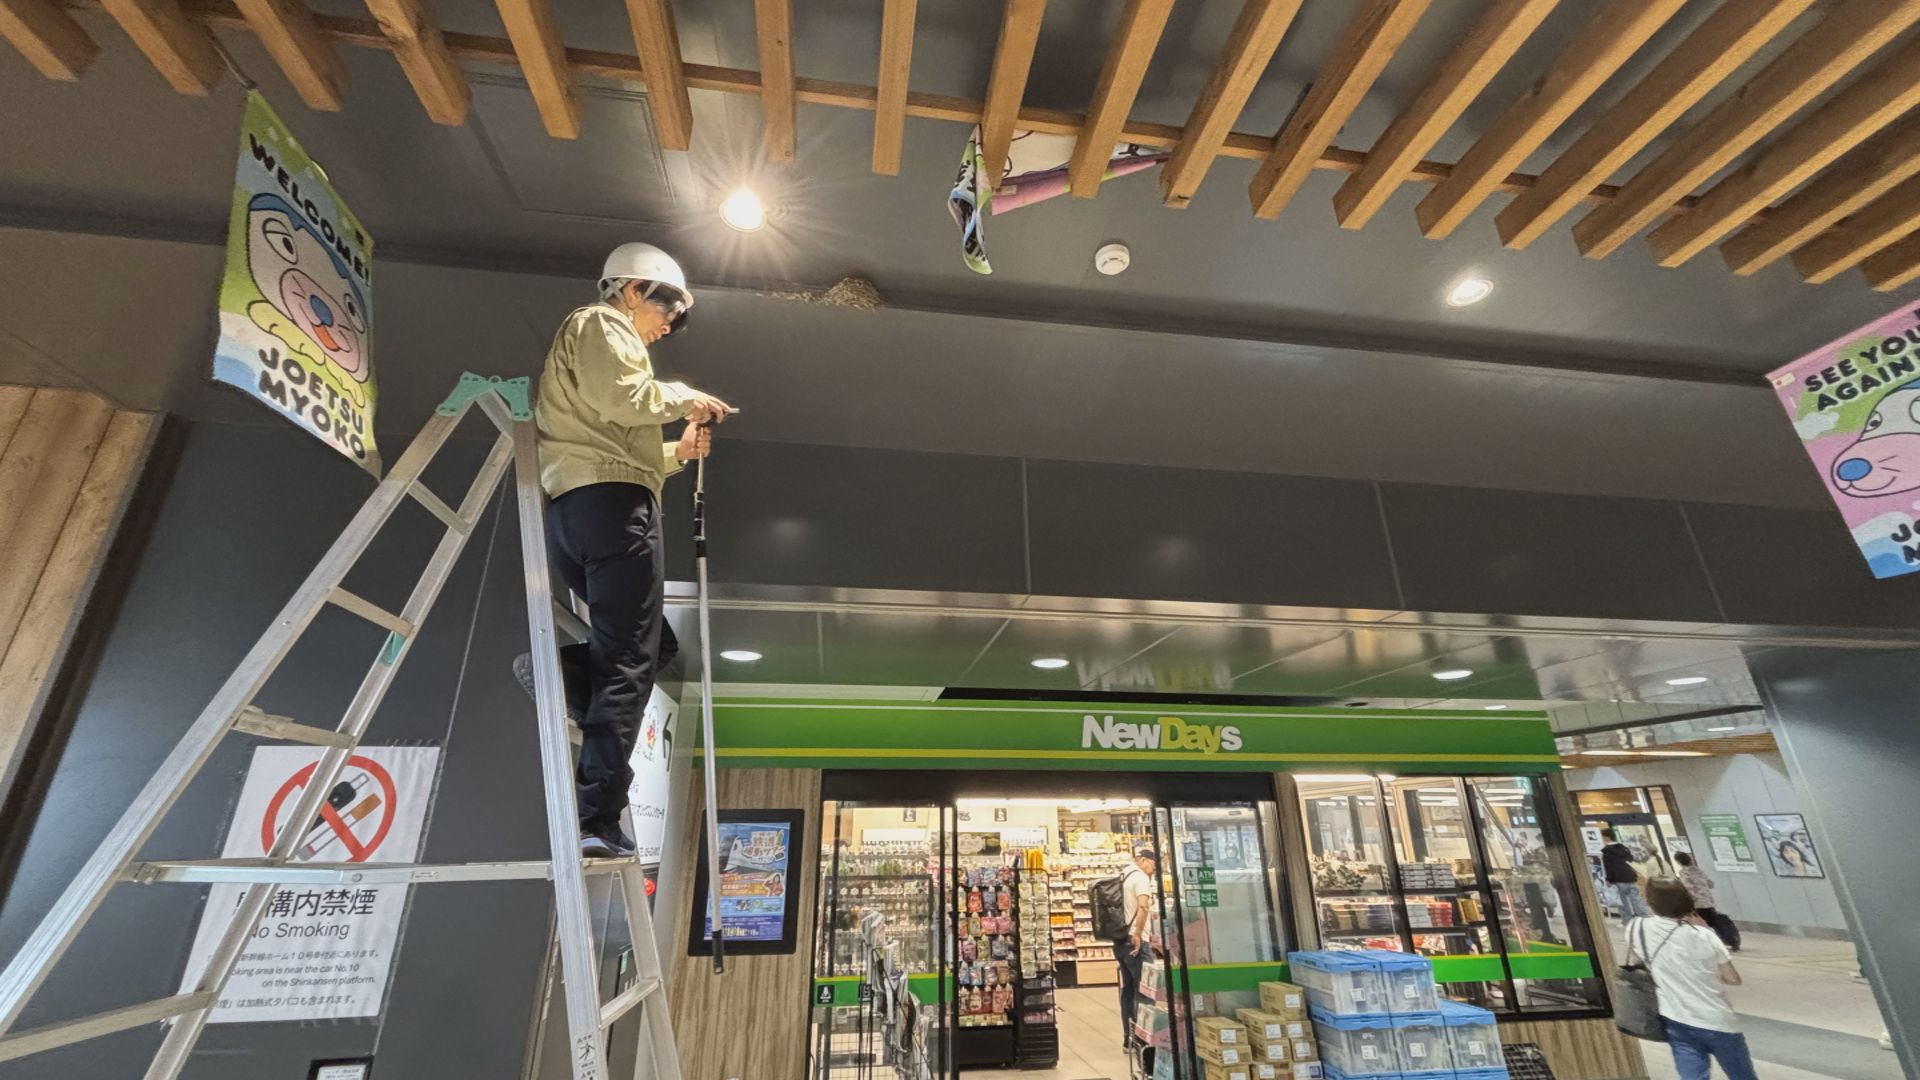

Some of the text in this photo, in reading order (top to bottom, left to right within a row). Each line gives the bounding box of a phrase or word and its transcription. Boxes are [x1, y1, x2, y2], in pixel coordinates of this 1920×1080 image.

[249, 133, 371, 286] WELCOME!
[1805, 324, 1920, 392] SEE YOU
[1817, 348, 1920, 411] AGAIN
[259, 347, 364, 437] JOETSU
[259, 371, 366, 460] MYOKO
[1081, 715, 1243, 755] NewDays
[233, 889, 378, 918] 構内禁煙
[275, 921, 350, 940] Smoking
[255, 967, 274, 975] area
[304, 965, 318, 973] the
